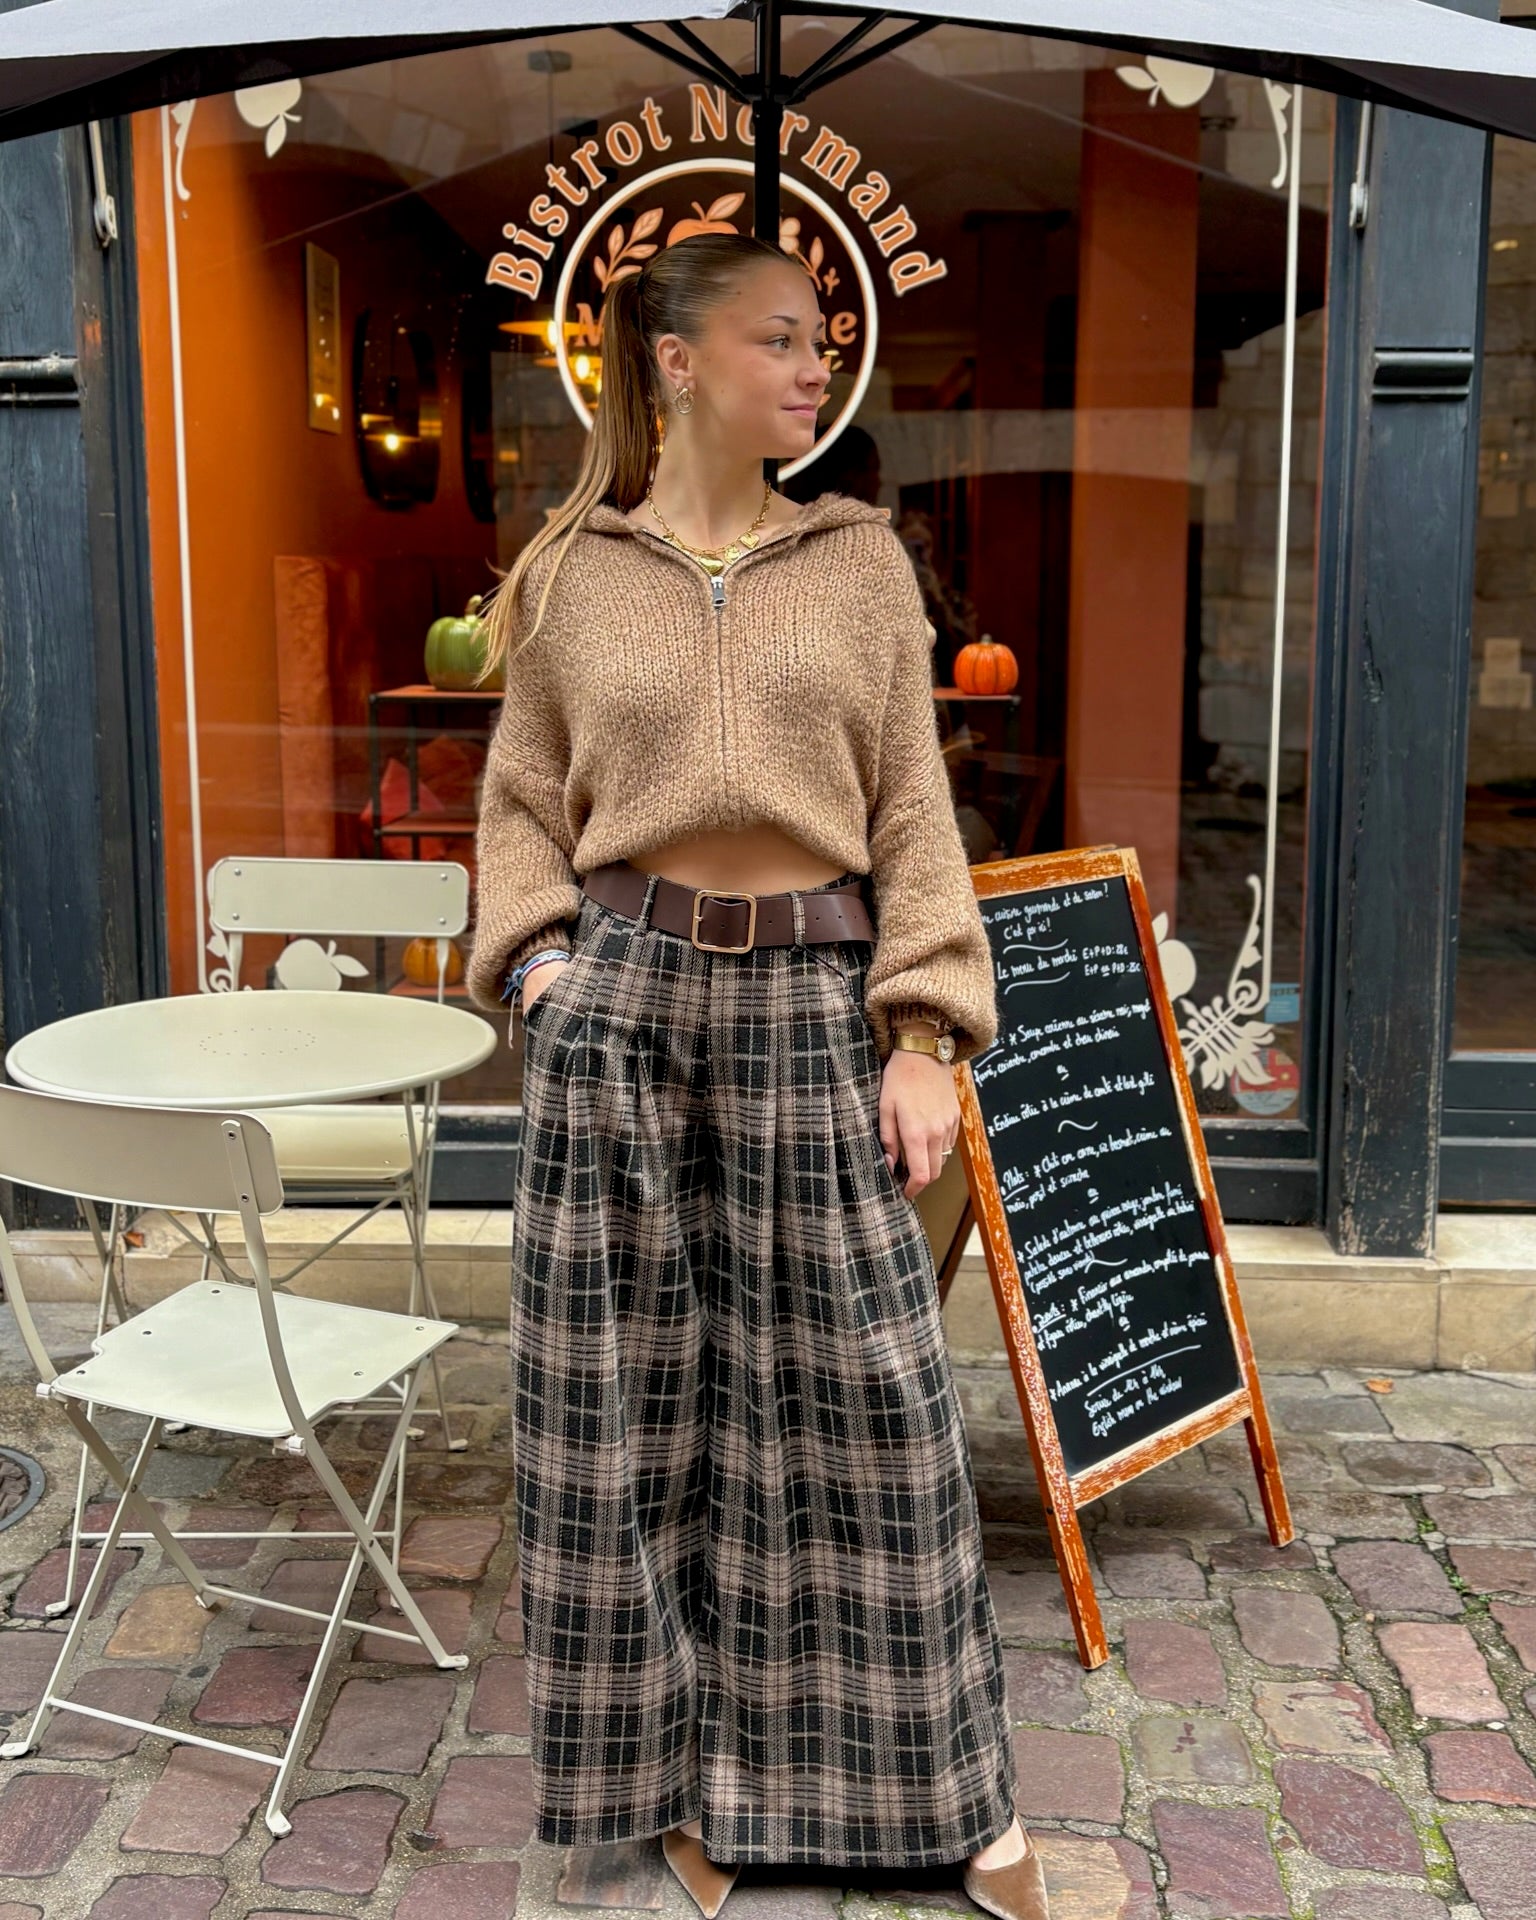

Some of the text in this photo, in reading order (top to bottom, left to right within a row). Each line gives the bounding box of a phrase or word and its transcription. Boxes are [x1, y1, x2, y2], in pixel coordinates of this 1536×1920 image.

[485, 97, 673, 300] Bistrot
[1063, 892, 1072, 907] et
[1073, 891, 1083, 904] de
[1004, 925, 1023, 940] C'est
[1026, 926, 1036, 942] par
[997, 961, 1009, 981] Le
[1011, 962, 1035, 977] menu
[1037, 955, 1050, 970] du
[1051, 948, 1078, 966] marché
[1017, 1025, 1044, 1043] Soupe
[1044, 1018, 1075, 1035] coréenne
[1076, 1015, 1089, 1026] au
[1089, 1009, 1115, 1024] sésame
[972, 1064, 998, 1088] fumé,
[1030, 1042, 1061, 1061] concombre
[1062, 1033, 1073, 1049] et
[1074, 1032, 1093, 1046] chou
[993, 1111, 1021, 1132] Endive
[1020, 1103, 1040, 1120] rôtie
[1041, 1099, 1048, 1113] à
[1049, 1097, 1059, 1109] la
[1059, 1092, 1082, 1105] crème
[1083, 1085, 1094, 1100] de
[1159, 1126, 1173, 1137] au
[1048, 1176, 1057, 1194] et
[1024, 1233, 1052, 1260] Salade
[1073, 1239, 1083, 1255] et
[1084, 1393, 1112, 1419] Service
[1112, 1387, 1124, 1403] de
